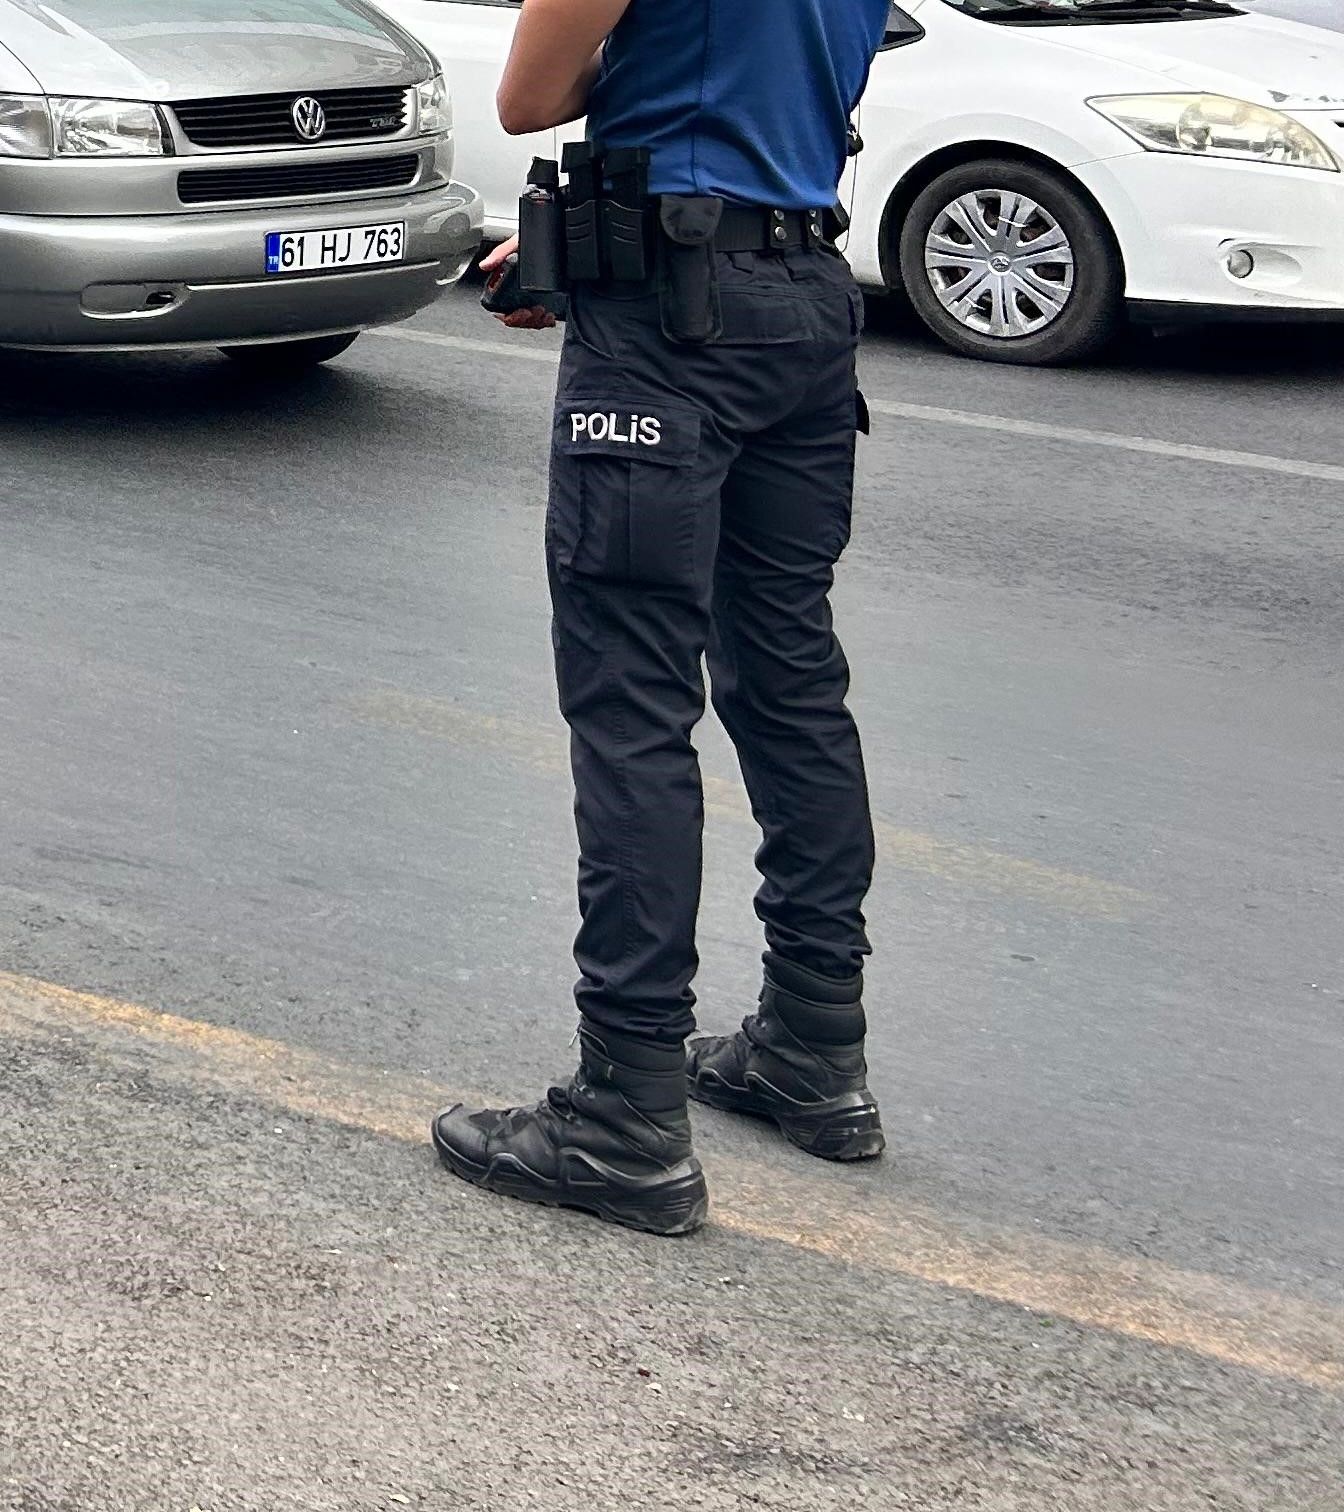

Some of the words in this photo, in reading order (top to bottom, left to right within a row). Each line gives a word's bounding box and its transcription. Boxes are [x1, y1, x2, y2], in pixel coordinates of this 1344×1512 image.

[281, 236, 305, 267] 61
[320, 232, 352, 265] HJ
[363, 227, 402, 260] 763
